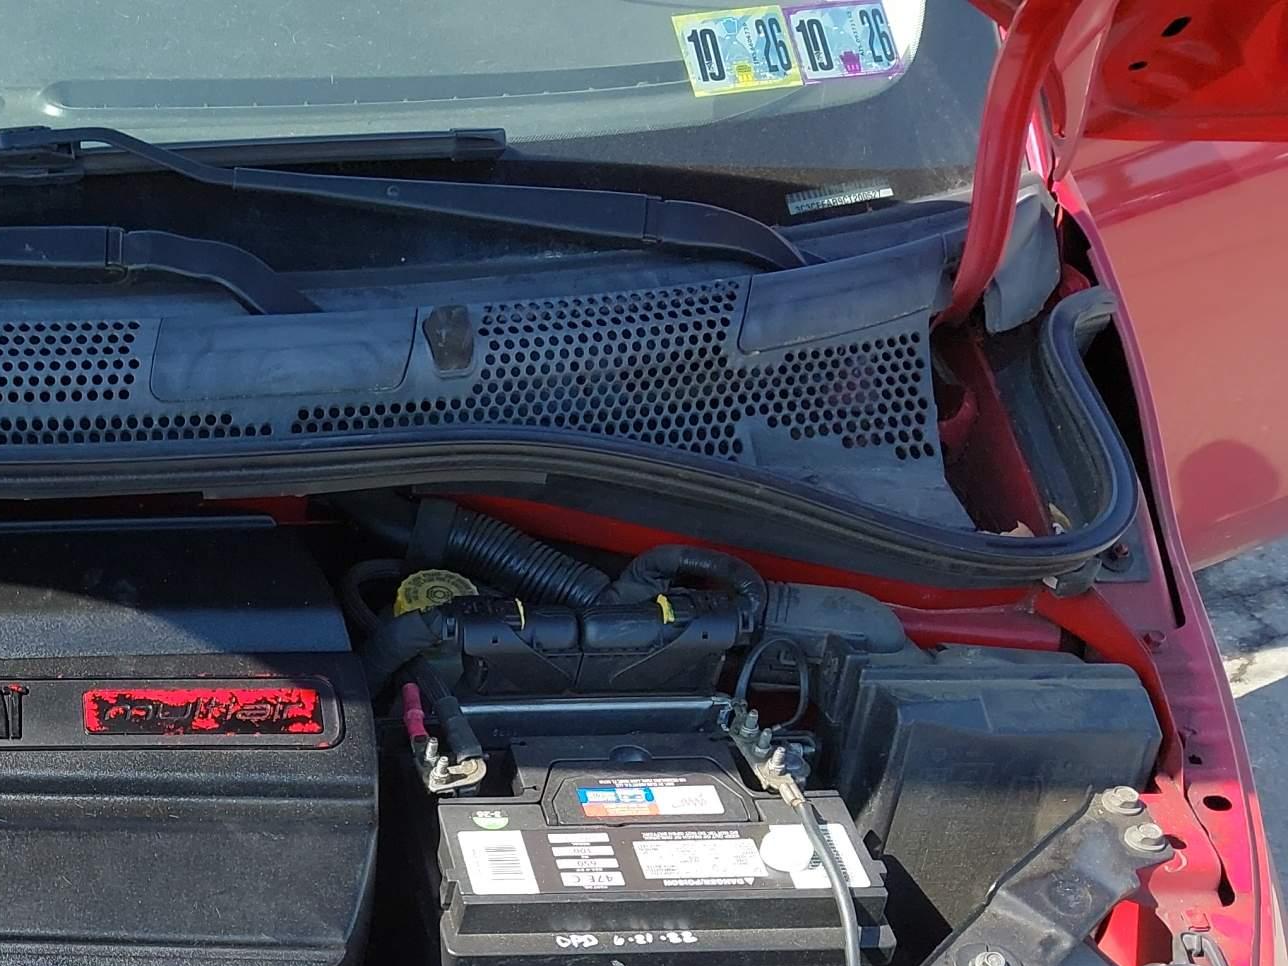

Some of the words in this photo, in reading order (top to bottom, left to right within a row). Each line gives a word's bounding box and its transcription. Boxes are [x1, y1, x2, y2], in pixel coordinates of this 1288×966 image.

[687, 28, 726, 82] 10
[756, 17, 793, 73] 26
[796, 19, 834, 72] 10
[859, 8, 895, 63] 26
